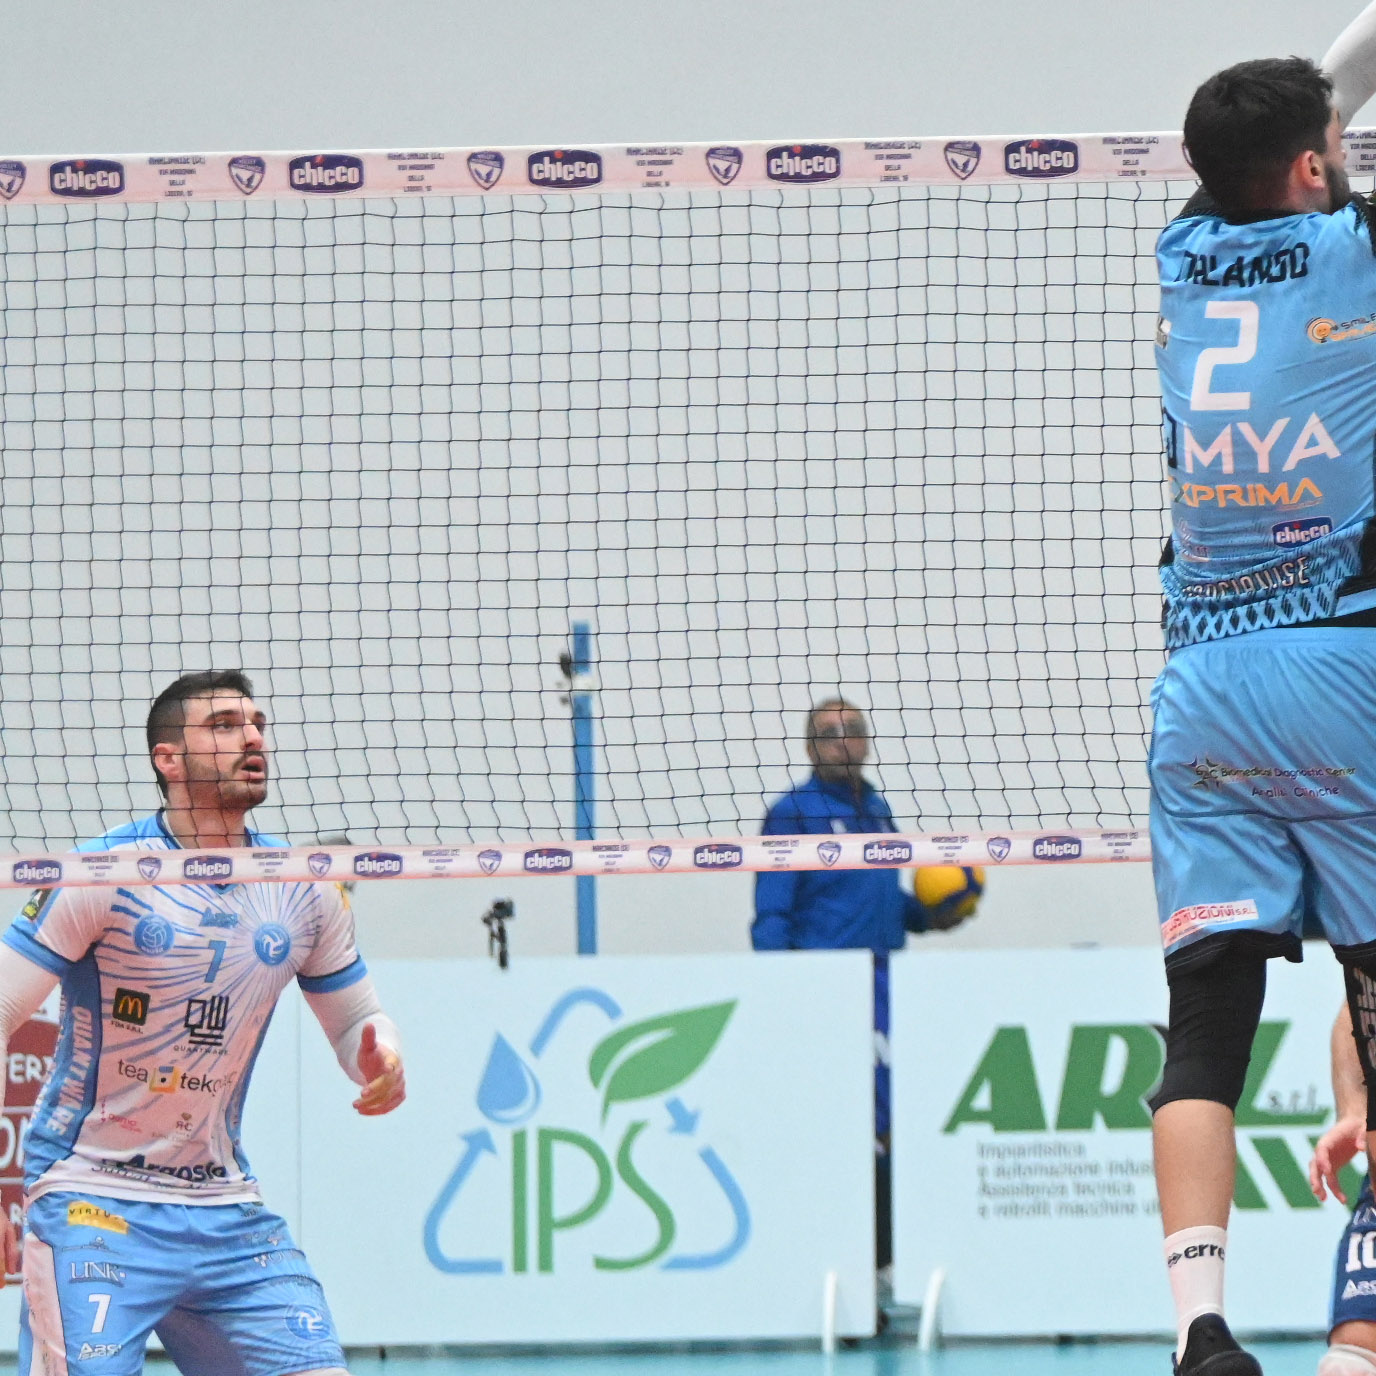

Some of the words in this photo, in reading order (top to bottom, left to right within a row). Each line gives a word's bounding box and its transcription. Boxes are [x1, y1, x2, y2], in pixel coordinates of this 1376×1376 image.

[293, 155, 359, 185] chicco
[532, 150, 598, 180] chicco
[770, 145, 836, 175] chicco
[1008, 140, 1075, 170] chicco
[54, 161, 121, 191] chicco
[1190, 300, 1260, 411] 2
[1183, 412, 1342, 474] MYA
[1276, 520, 1330, 544] chicco
[526, 850, 570, 869] chicco
[696, 845, 740, 864] chicco
[865, 841, 909, 860] chicco
[1035, 838, 1079, 857] chicco
[15, 861, 60, 880] chicco
[186, 857, 230, 876] chicco
[356, 853, 400, 873] chicco
[204, 940, 227, 983] 7
[511, 1119, 677, 1275] IPS
[88, 1293, 112, 1334] 7
